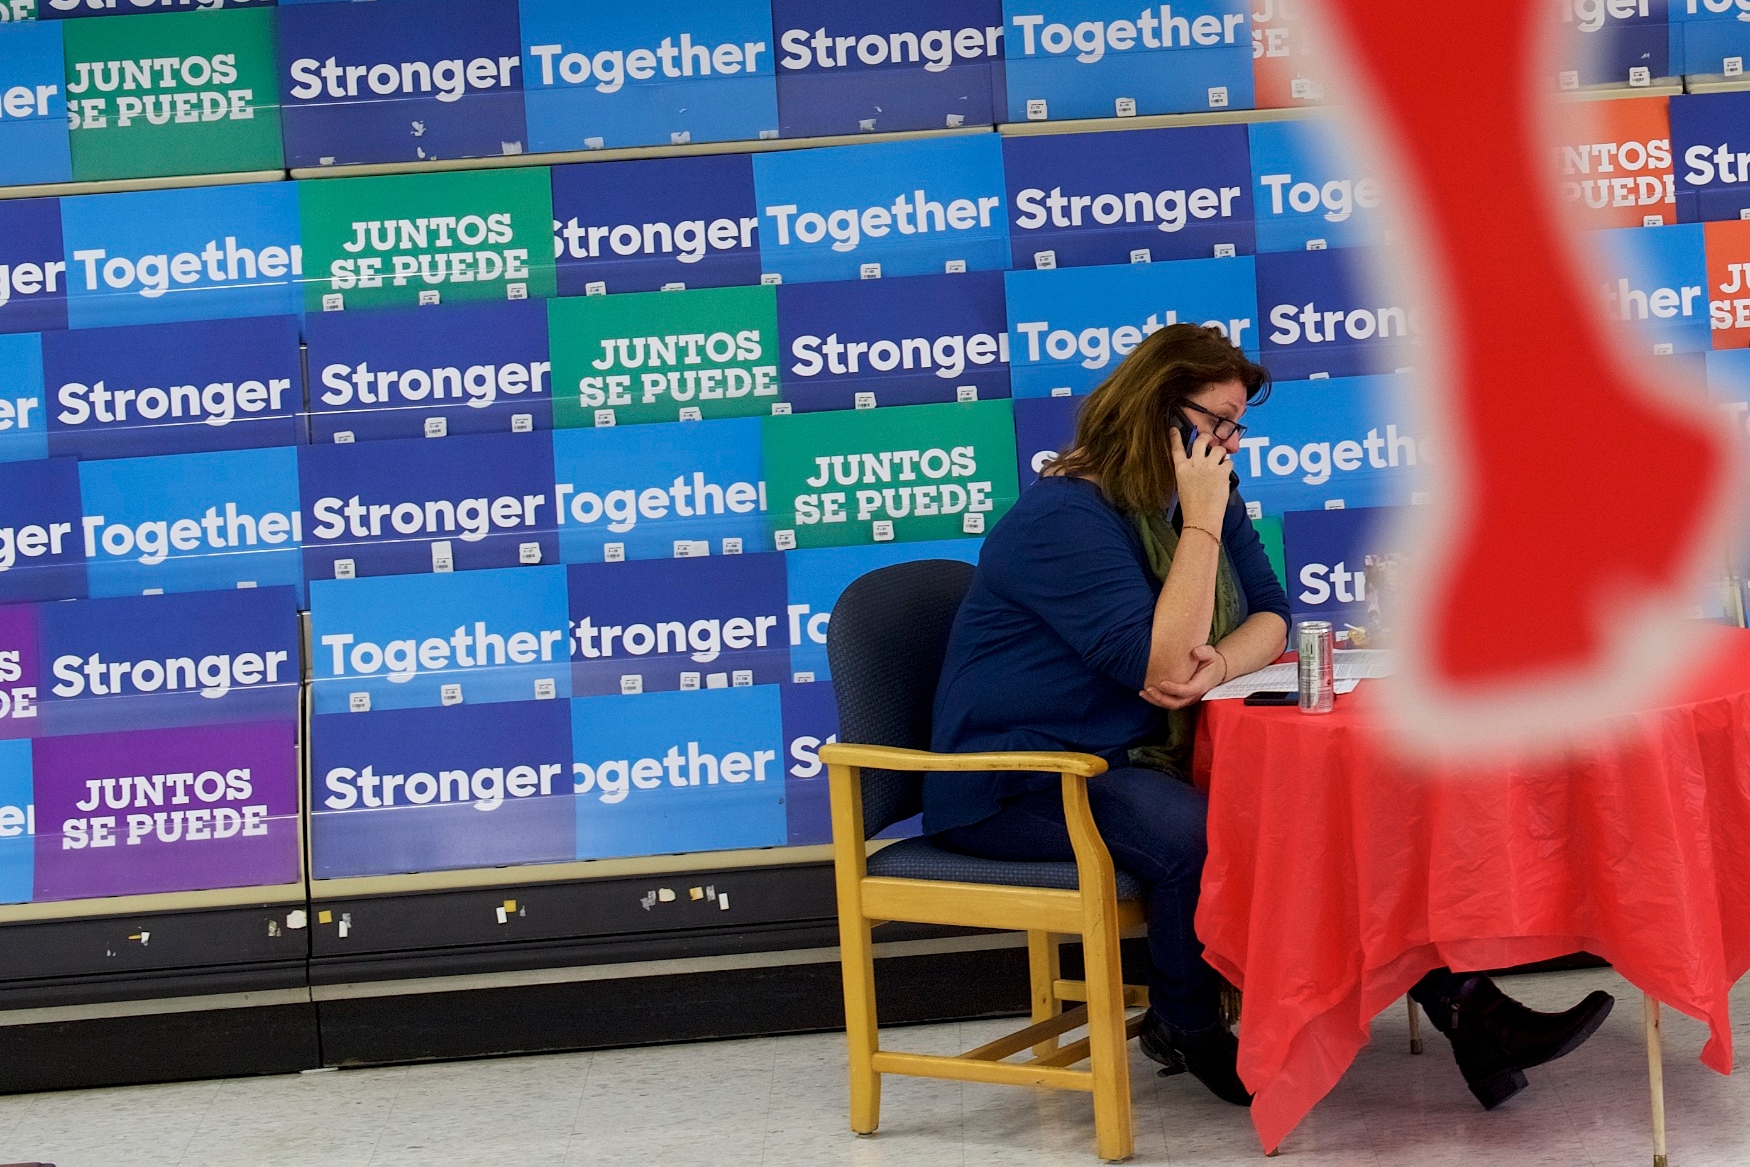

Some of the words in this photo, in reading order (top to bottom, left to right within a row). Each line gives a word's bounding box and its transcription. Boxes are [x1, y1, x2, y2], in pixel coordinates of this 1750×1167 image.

[781, 27, 1003, 72] Stronger
[1013, 5, 1244, 63] Together
[67, 54, 238, 94] JUNTOS
[290, 56, 519, 107] Stronger
[531, 34, 765, 93] Together
[117, 89, 254, 126] PUEDE
[766, 190, 999, 252] Together
[1016, 187, 1240, 232] Stronger
[343, 214, 512, 252] JUNTOS
[331, 258, 382, 289] SE
[393, 249, 528, 286] PUEDE
[592, 330, 761, 370] JUNTOS
[58, 379, 292, 427] Stronger
[320, 362, 550, 414] Stronger
[580, 375, 631, 407] SE
[641, 366, 777, 403] PUEDE
[807, 446, 977, 487] JUNTOS
[313, 495, 544, 547] Stronger
[795, 492, 846, 525] SE
[856, 482, 992, 521] PUEDE
[52, 651, 287, 698] Stronger
[322, 622, 561, 682] Together
[76, 769, 252, 811] JUNTOS
[324, 764, 561, 814] Stronger
[63, 816, 115, 849] SE
[127, 805, 267, 845] PUEDE
